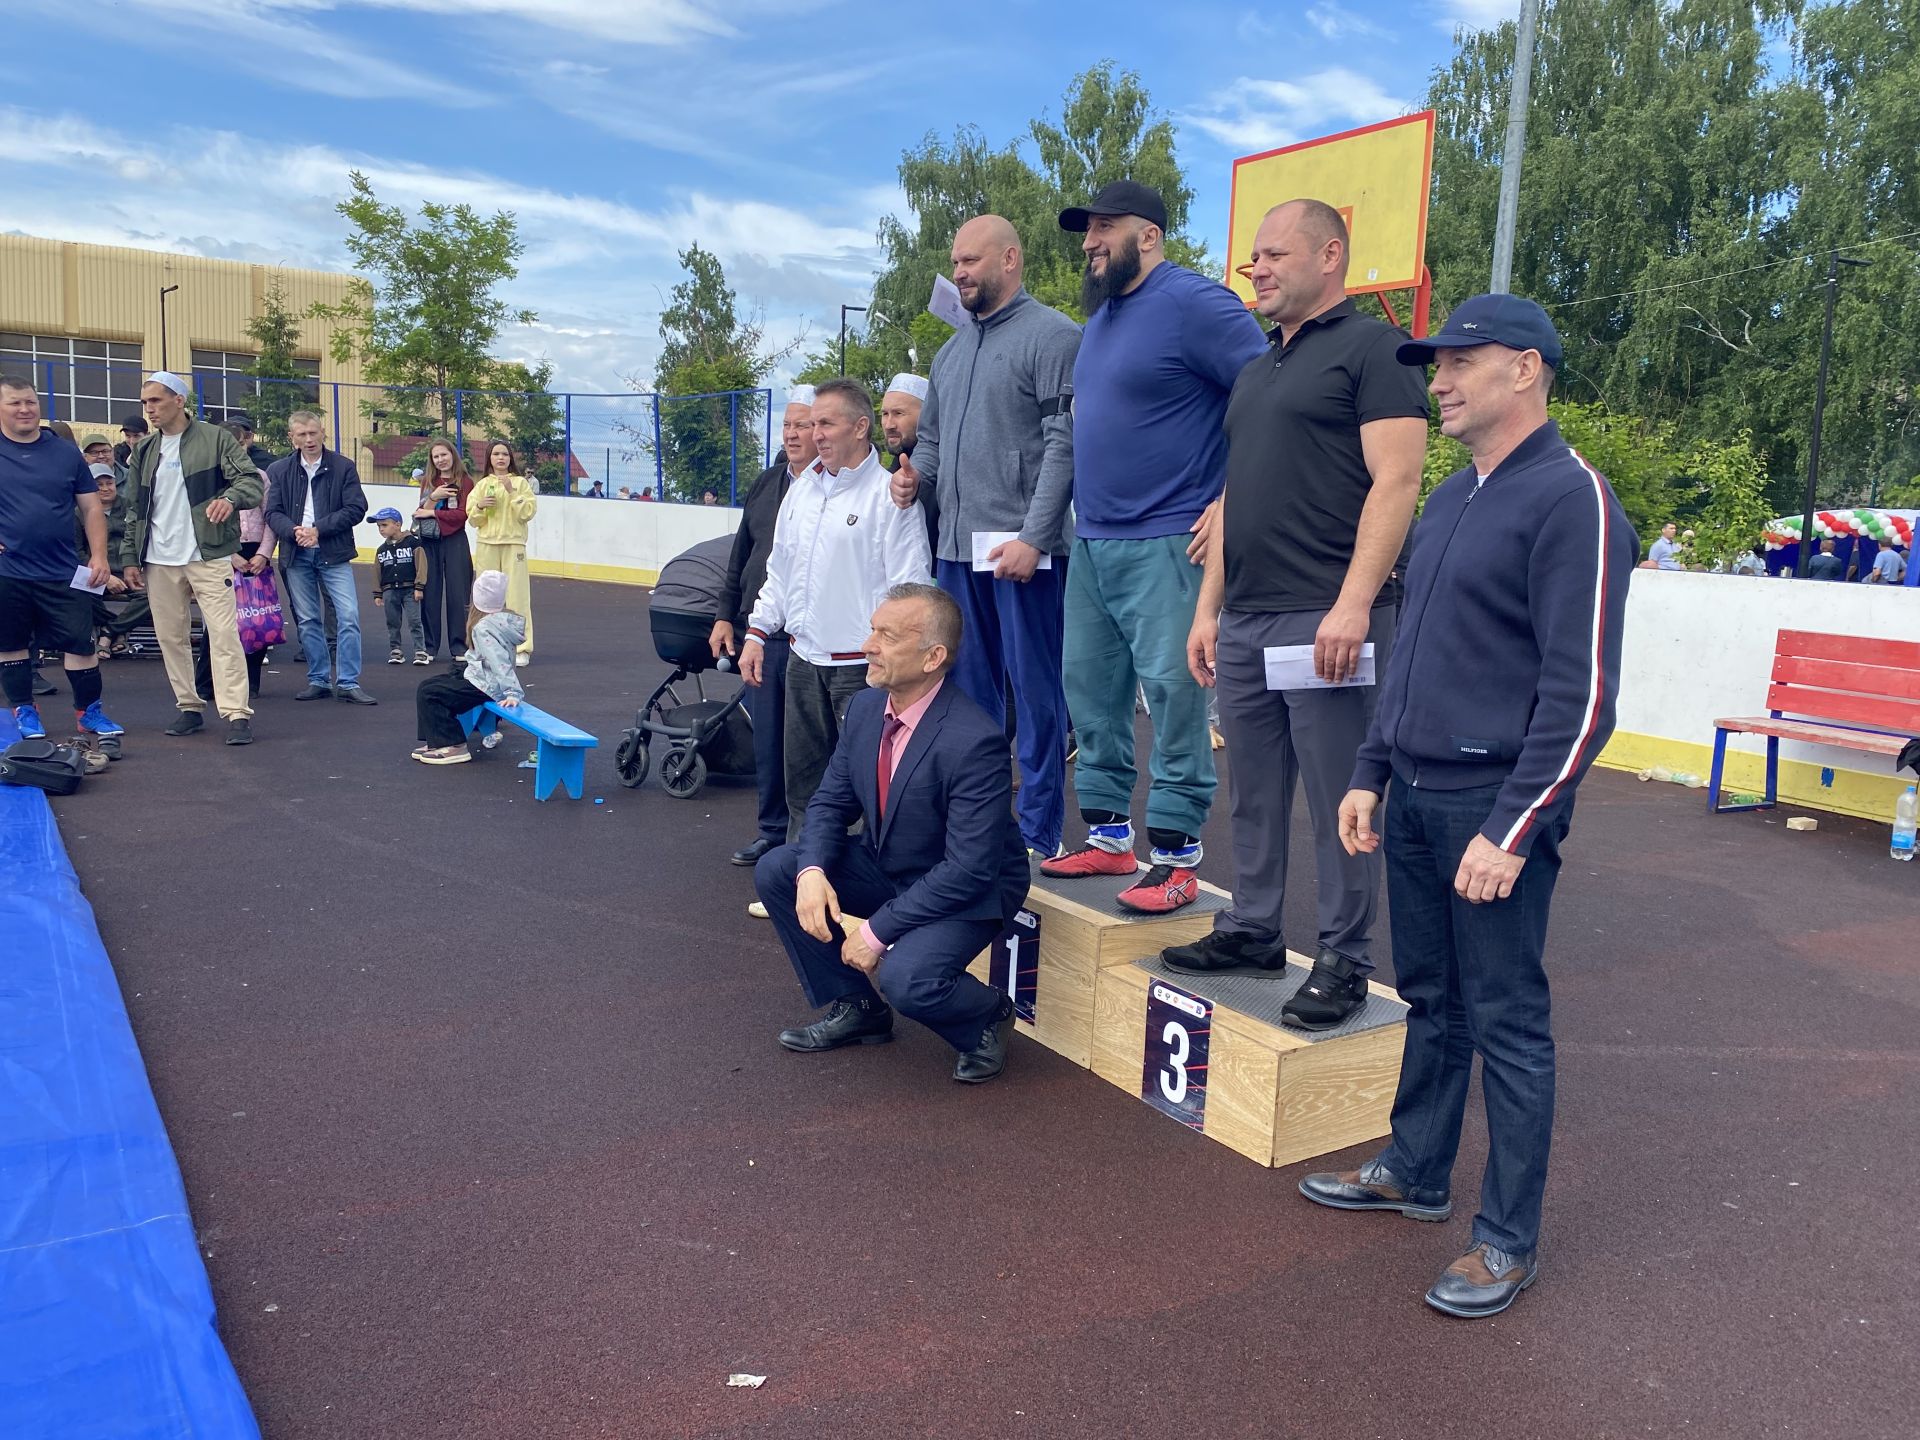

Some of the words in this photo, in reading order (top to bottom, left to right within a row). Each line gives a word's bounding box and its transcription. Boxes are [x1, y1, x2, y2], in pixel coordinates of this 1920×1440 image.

[235, 603, 281, 620] ildberries
[1006, 934, 1019, 1003] 1
[1160, 1021, 1190, 1103] 3
